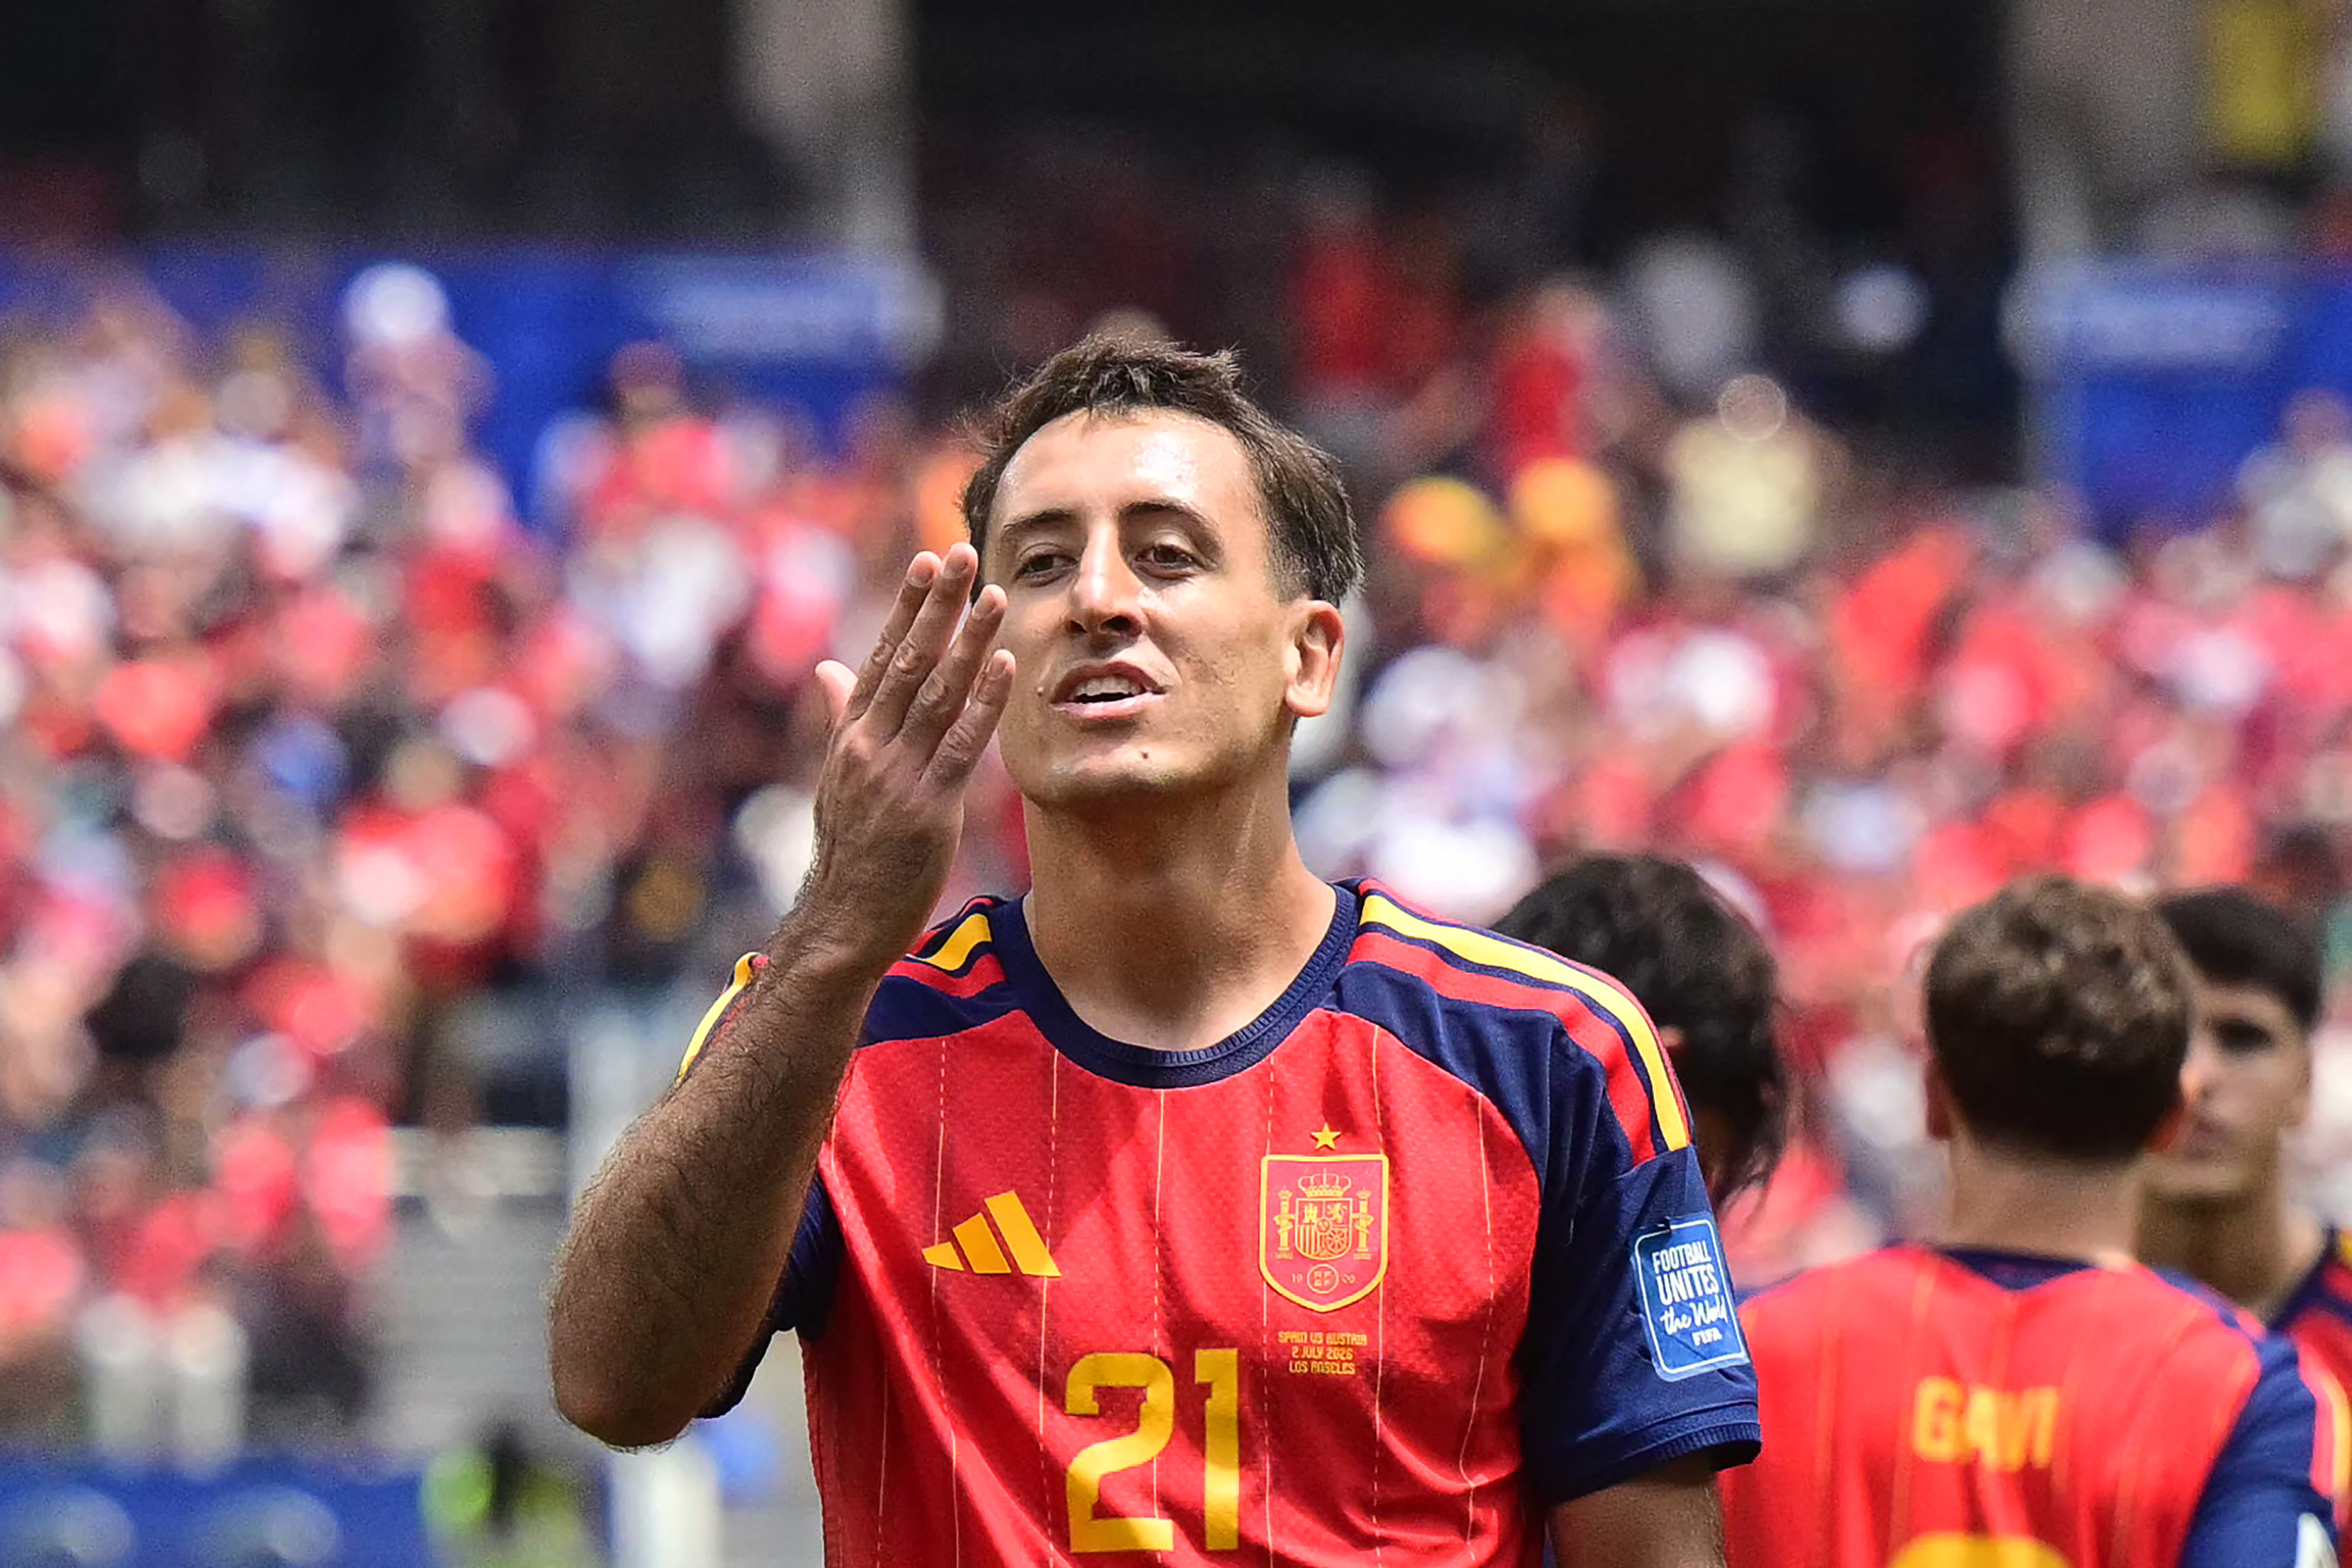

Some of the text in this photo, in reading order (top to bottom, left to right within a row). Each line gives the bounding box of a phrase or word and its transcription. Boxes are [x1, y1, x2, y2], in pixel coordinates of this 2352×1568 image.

[1652, 1240, 1712, 1274] FOOTBALL
[1656, 1263, 1720, 1305] UNITES
[1660, 1295, 1728, 1335] the World
[1278, 1331, 1308, 1343] SPAIN
[1326, 1332, 1368, 1346] AUSTRIA
[1691, 1327, 1723, 1346] FIFA
[1292, 1346, 1353, 1360] 2 JULY 2026
[1289, 1360, 1355, 1375] LOS ANGELES
[1065, 1348, 1239, 1553] 21
